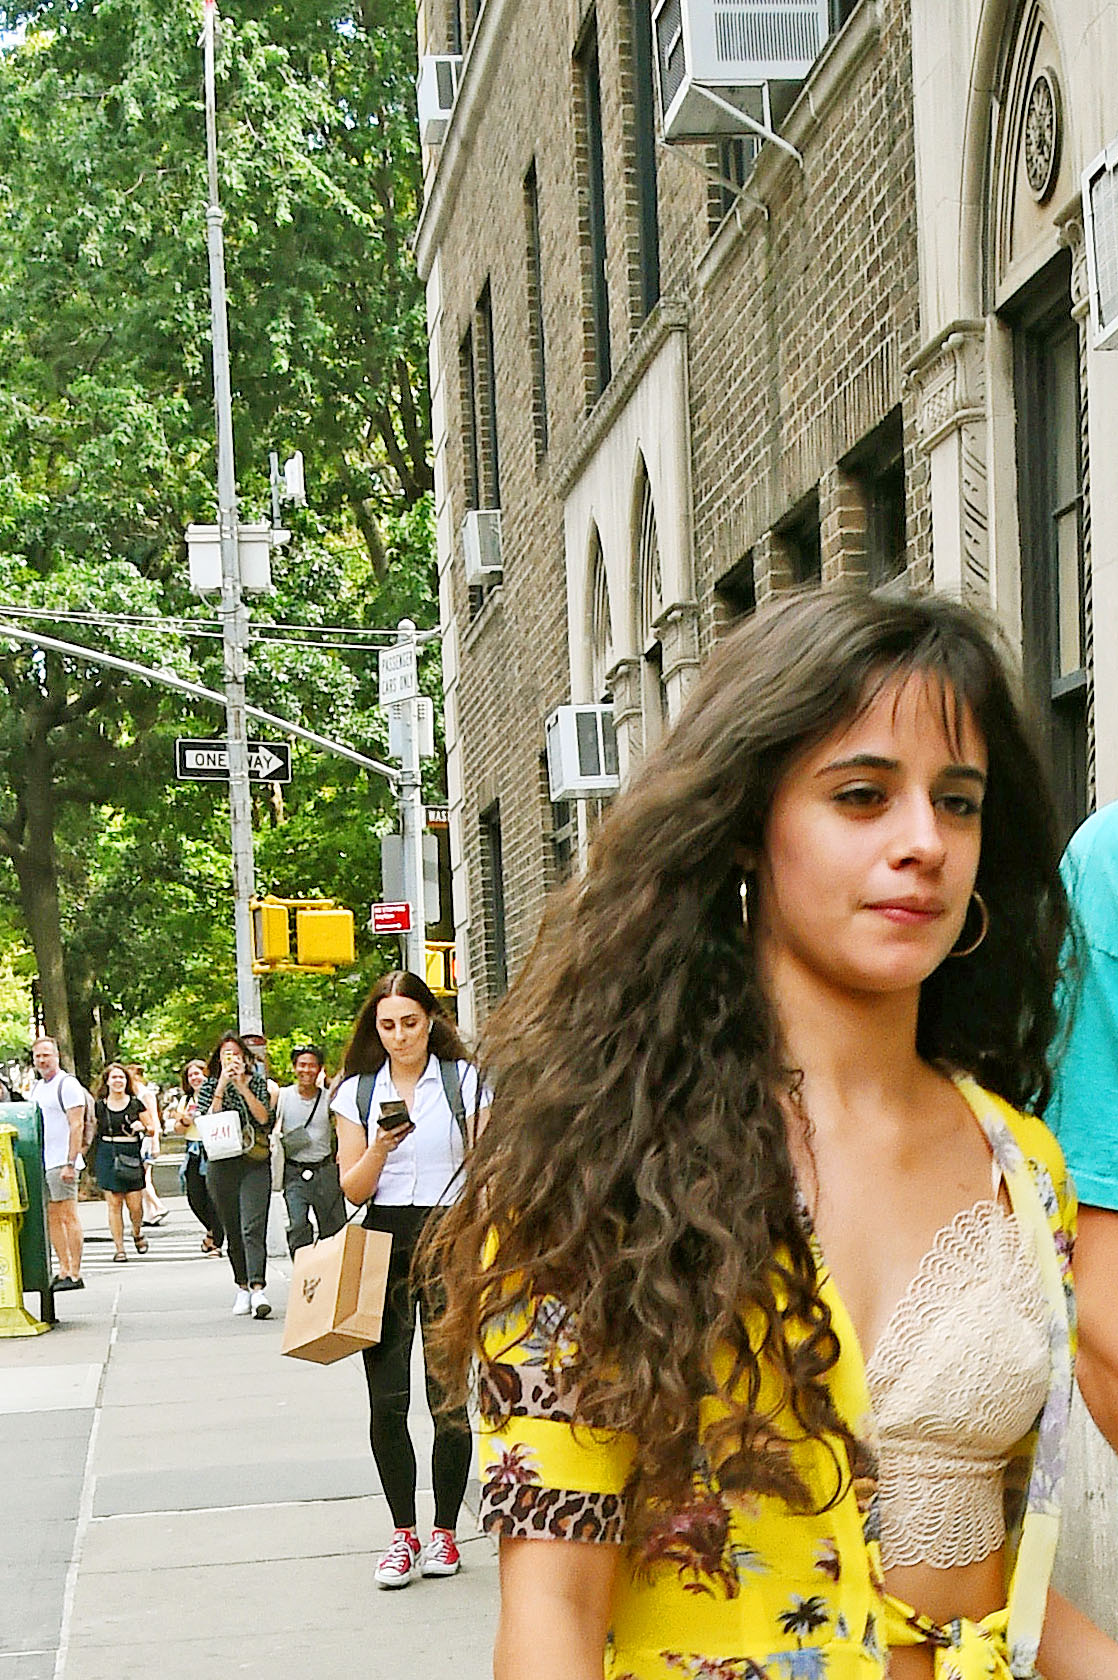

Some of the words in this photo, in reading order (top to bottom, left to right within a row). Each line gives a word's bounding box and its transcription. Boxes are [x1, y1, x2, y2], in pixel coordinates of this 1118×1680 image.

[382, 651, 413, 674] PASSENGER
[382, 677, 397, 696] CARS
[400, 673, 413, 690] ONLY
[195, 753, 227, 767] ONE
